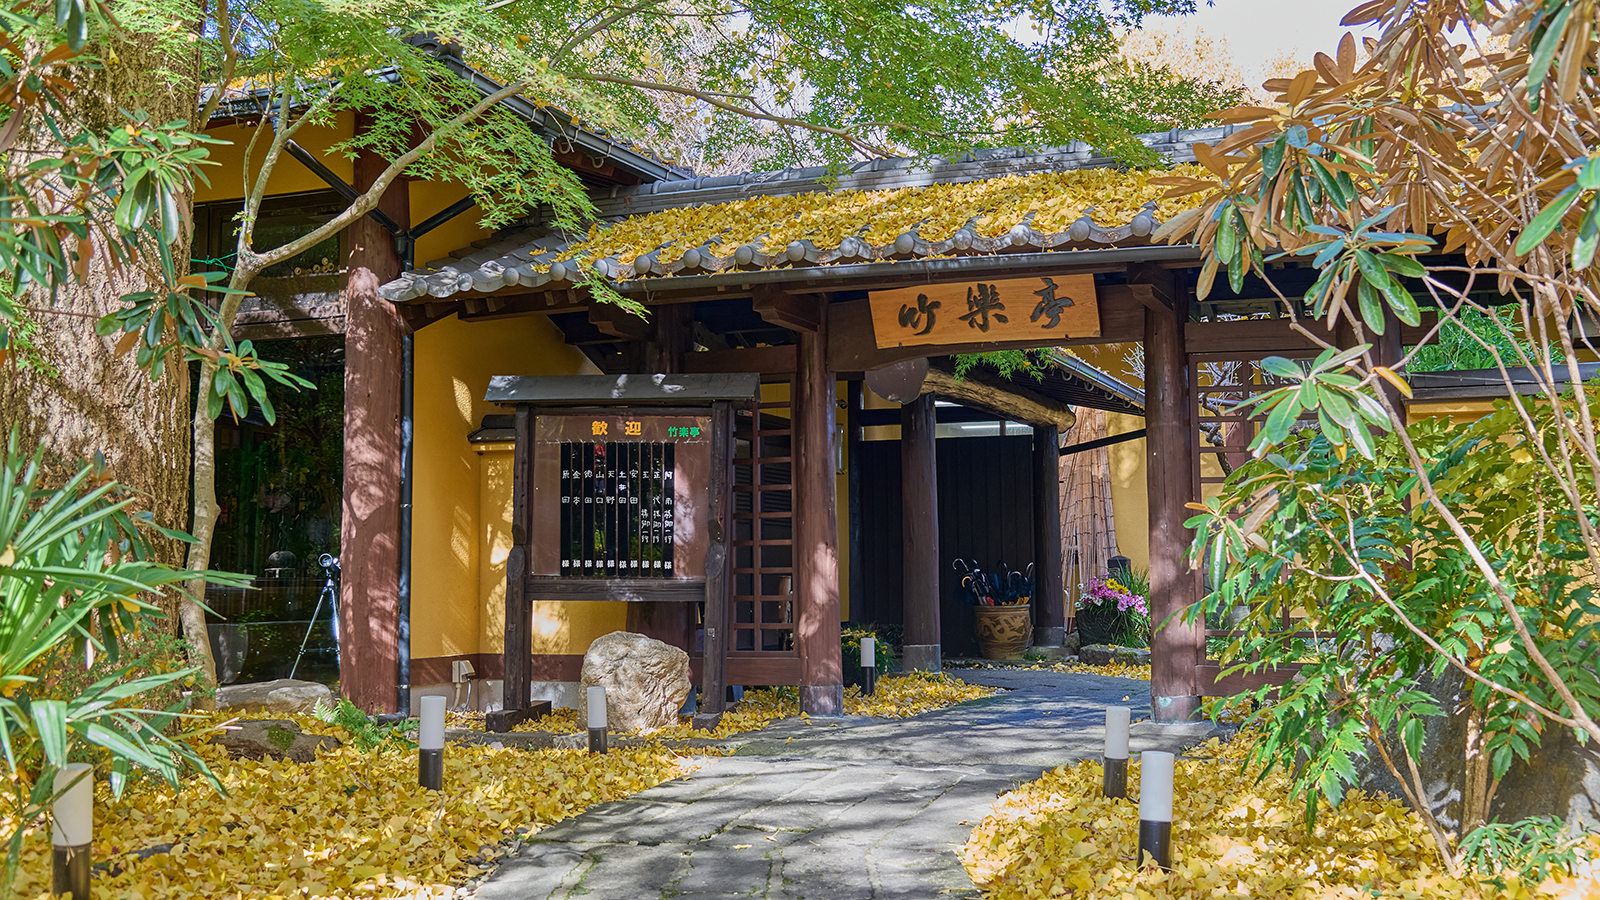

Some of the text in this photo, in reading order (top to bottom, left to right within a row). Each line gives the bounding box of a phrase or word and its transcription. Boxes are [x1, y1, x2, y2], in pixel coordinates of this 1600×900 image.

[591, 420, 642, 436] 歓迎
[667, 426, 701, 438] 竹楽亭
